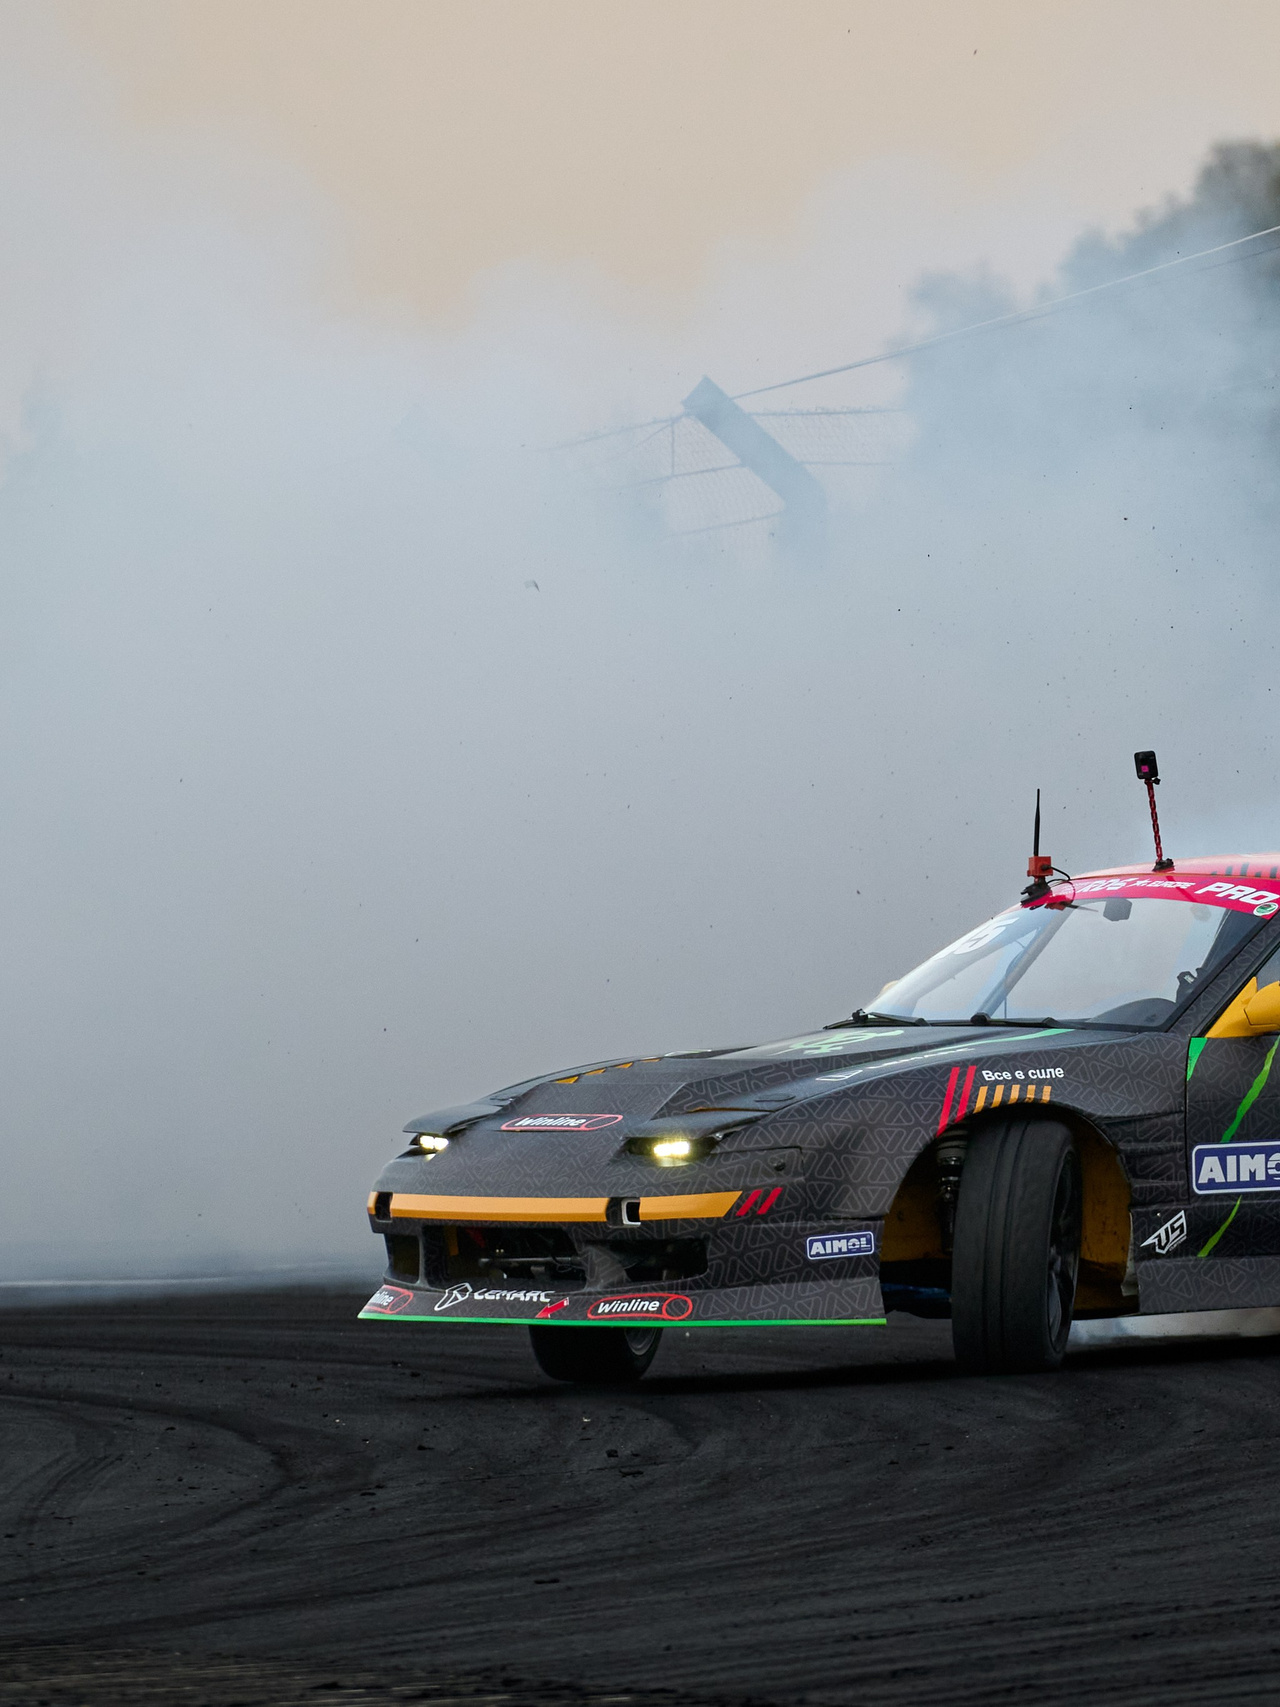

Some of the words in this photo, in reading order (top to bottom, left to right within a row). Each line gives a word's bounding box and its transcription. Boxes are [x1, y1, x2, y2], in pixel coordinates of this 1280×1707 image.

[1194, 881, 1280, 905] PRO
[981, 1070, 1013, 1081] Все
[1015, 1070, 1026, 1080] в
[1028, 1067, 1065, 1079] силе
[514, 1117, 587, 1127] Winline
[810, 1237, 872, 1256] AIMOL
[597, 1297, 661, 1314] Winline
